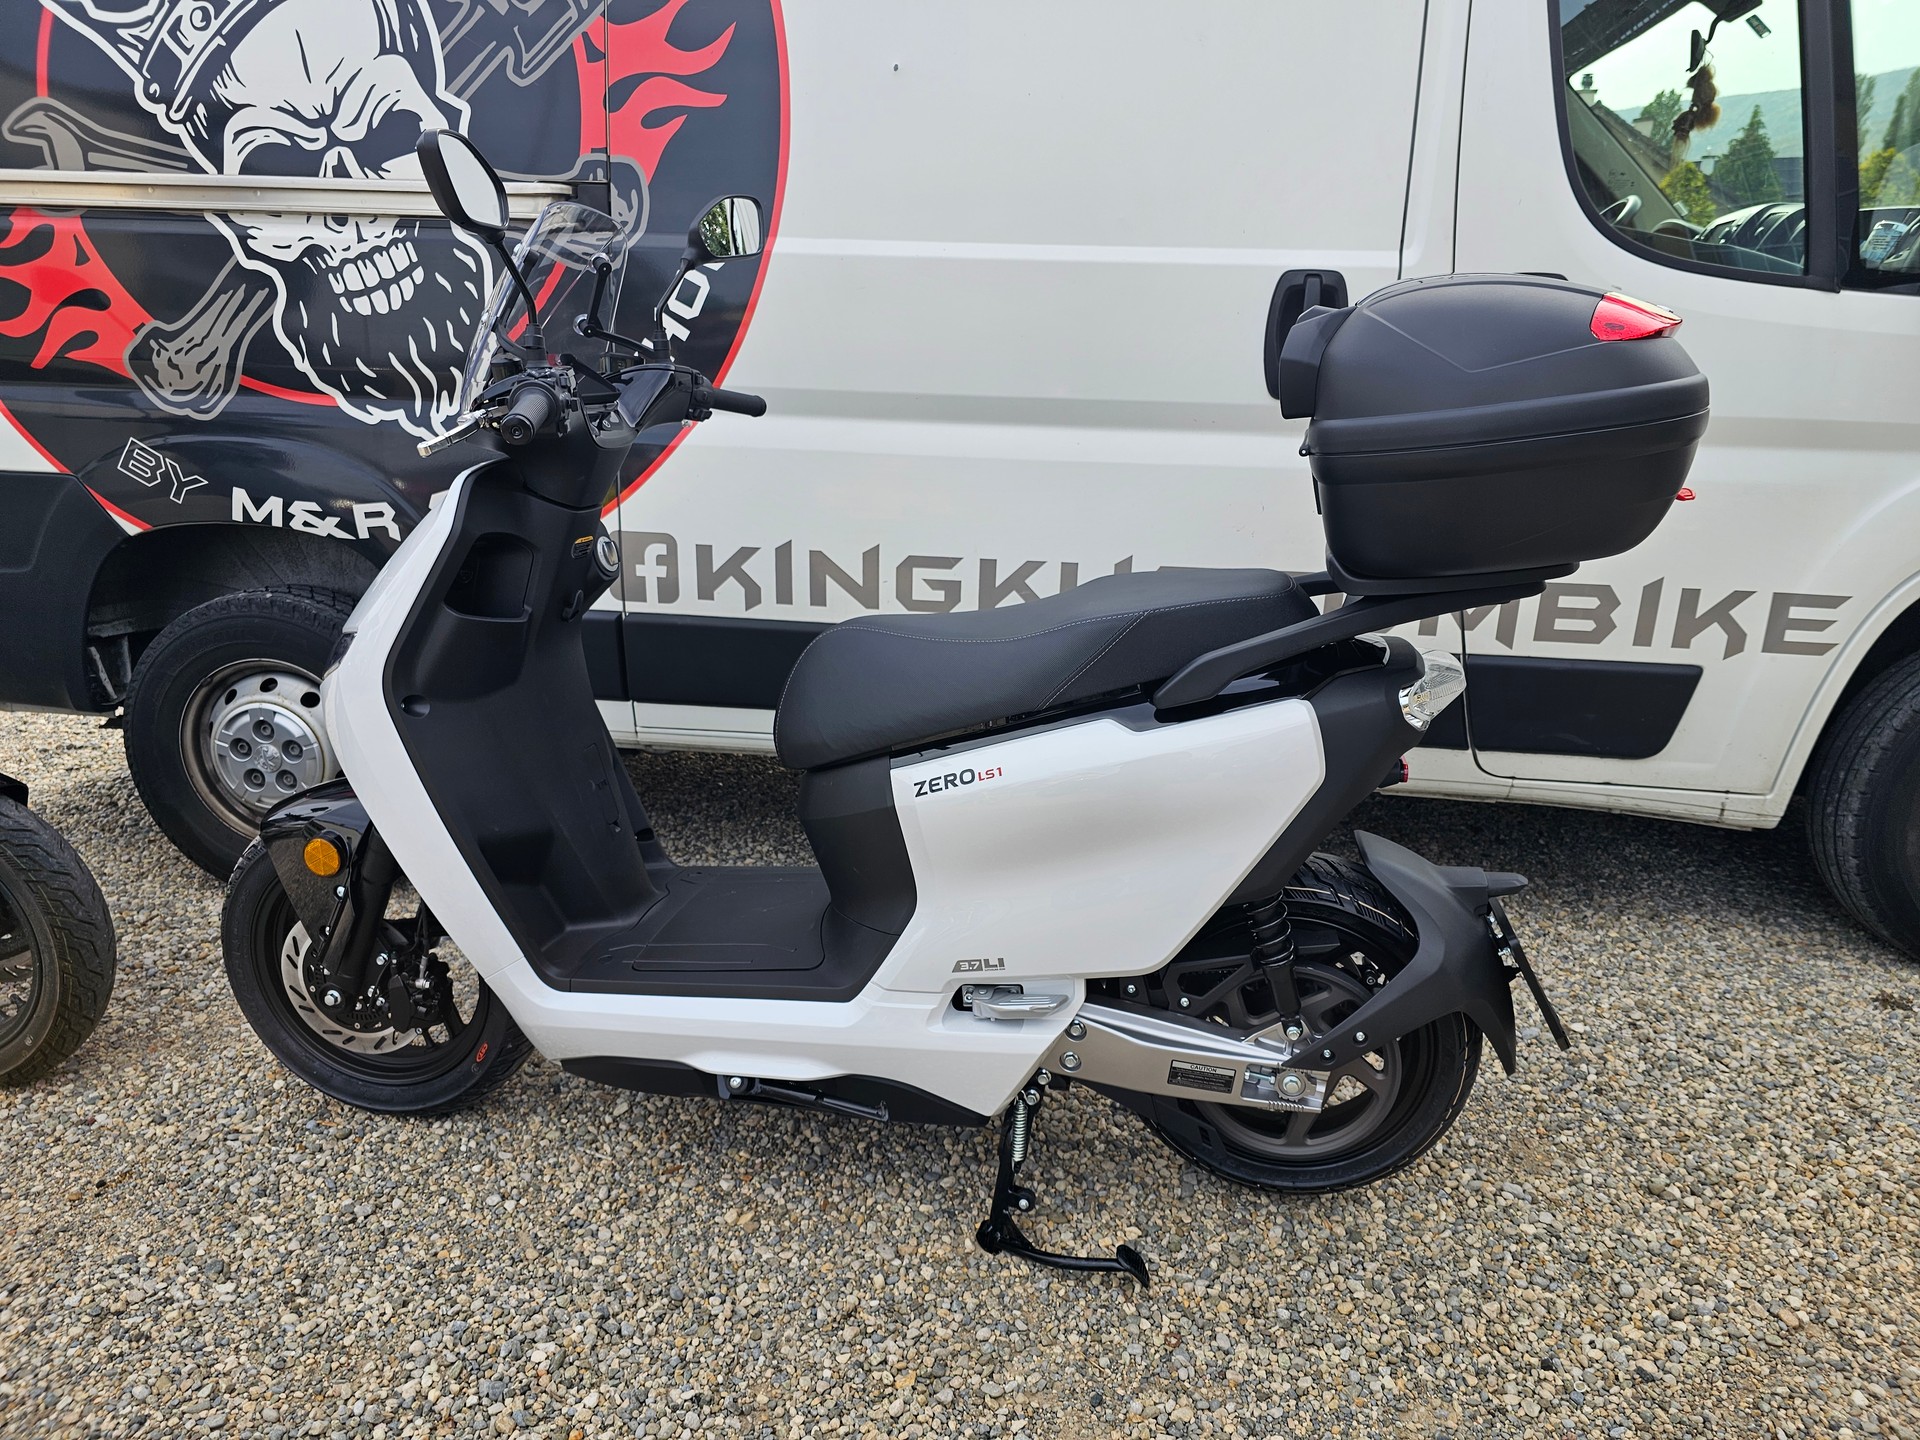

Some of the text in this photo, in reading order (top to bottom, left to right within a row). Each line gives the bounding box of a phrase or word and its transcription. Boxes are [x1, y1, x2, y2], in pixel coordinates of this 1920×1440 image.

[118, 437, 401, 541] BY M&R
[913, 767, 1003, 798] ZERO LS1
[1190, 1064, 1218, 1073] CAUTION
